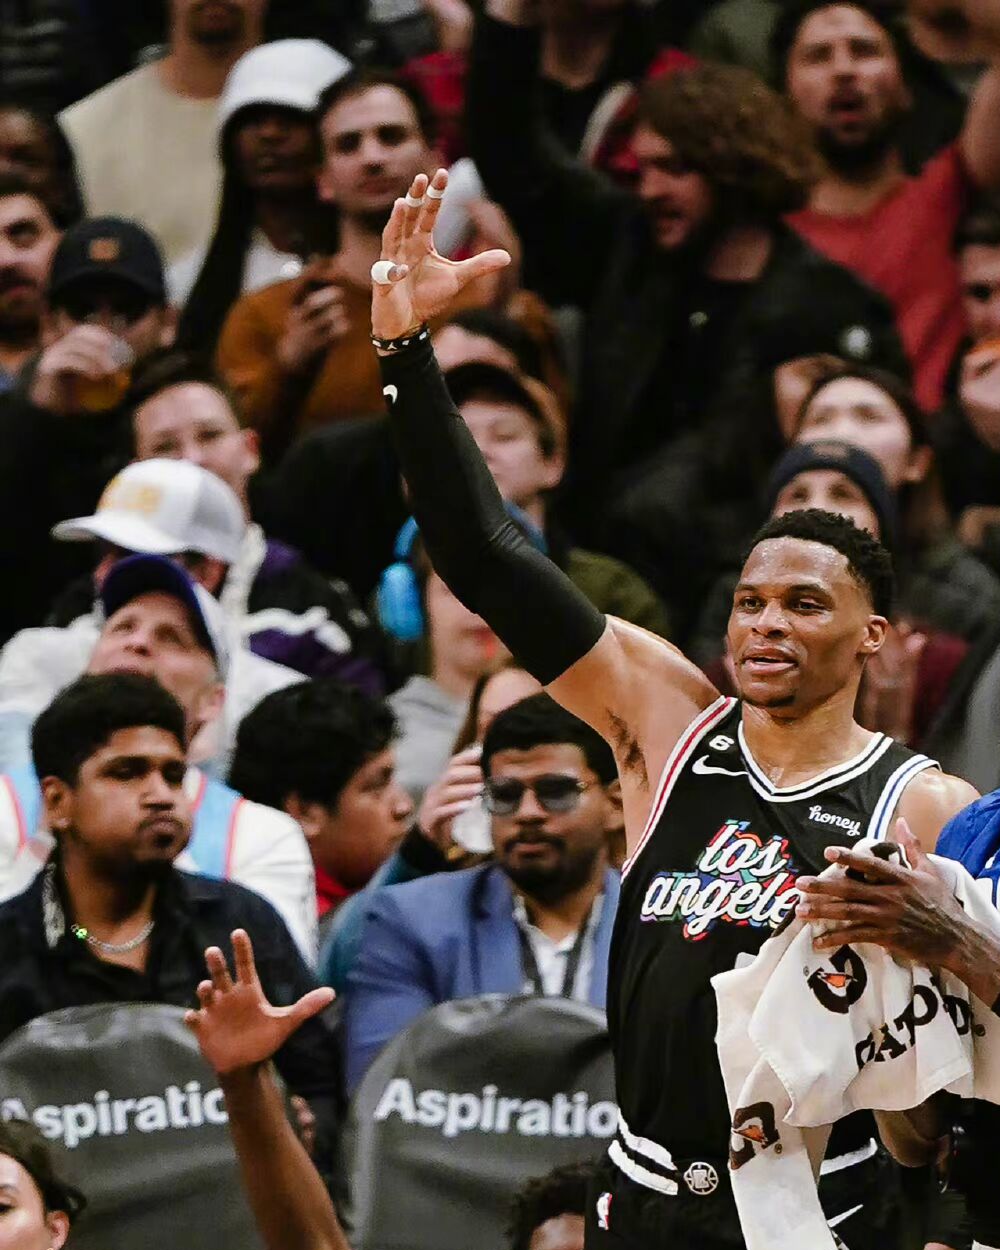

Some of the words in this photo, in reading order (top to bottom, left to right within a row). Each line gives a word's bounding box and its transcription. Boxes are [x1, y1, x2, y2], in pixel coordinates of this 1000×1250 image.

[709, 734, 734, 751] 6
[808, 805, 861, 836] honey
[699, 822, 788, 877] los
[640, 872, 801, 935] angele
[2, 1080, 229, 1148] Aspiratio
[373, 1078, 619, 1137] Aspiratio
